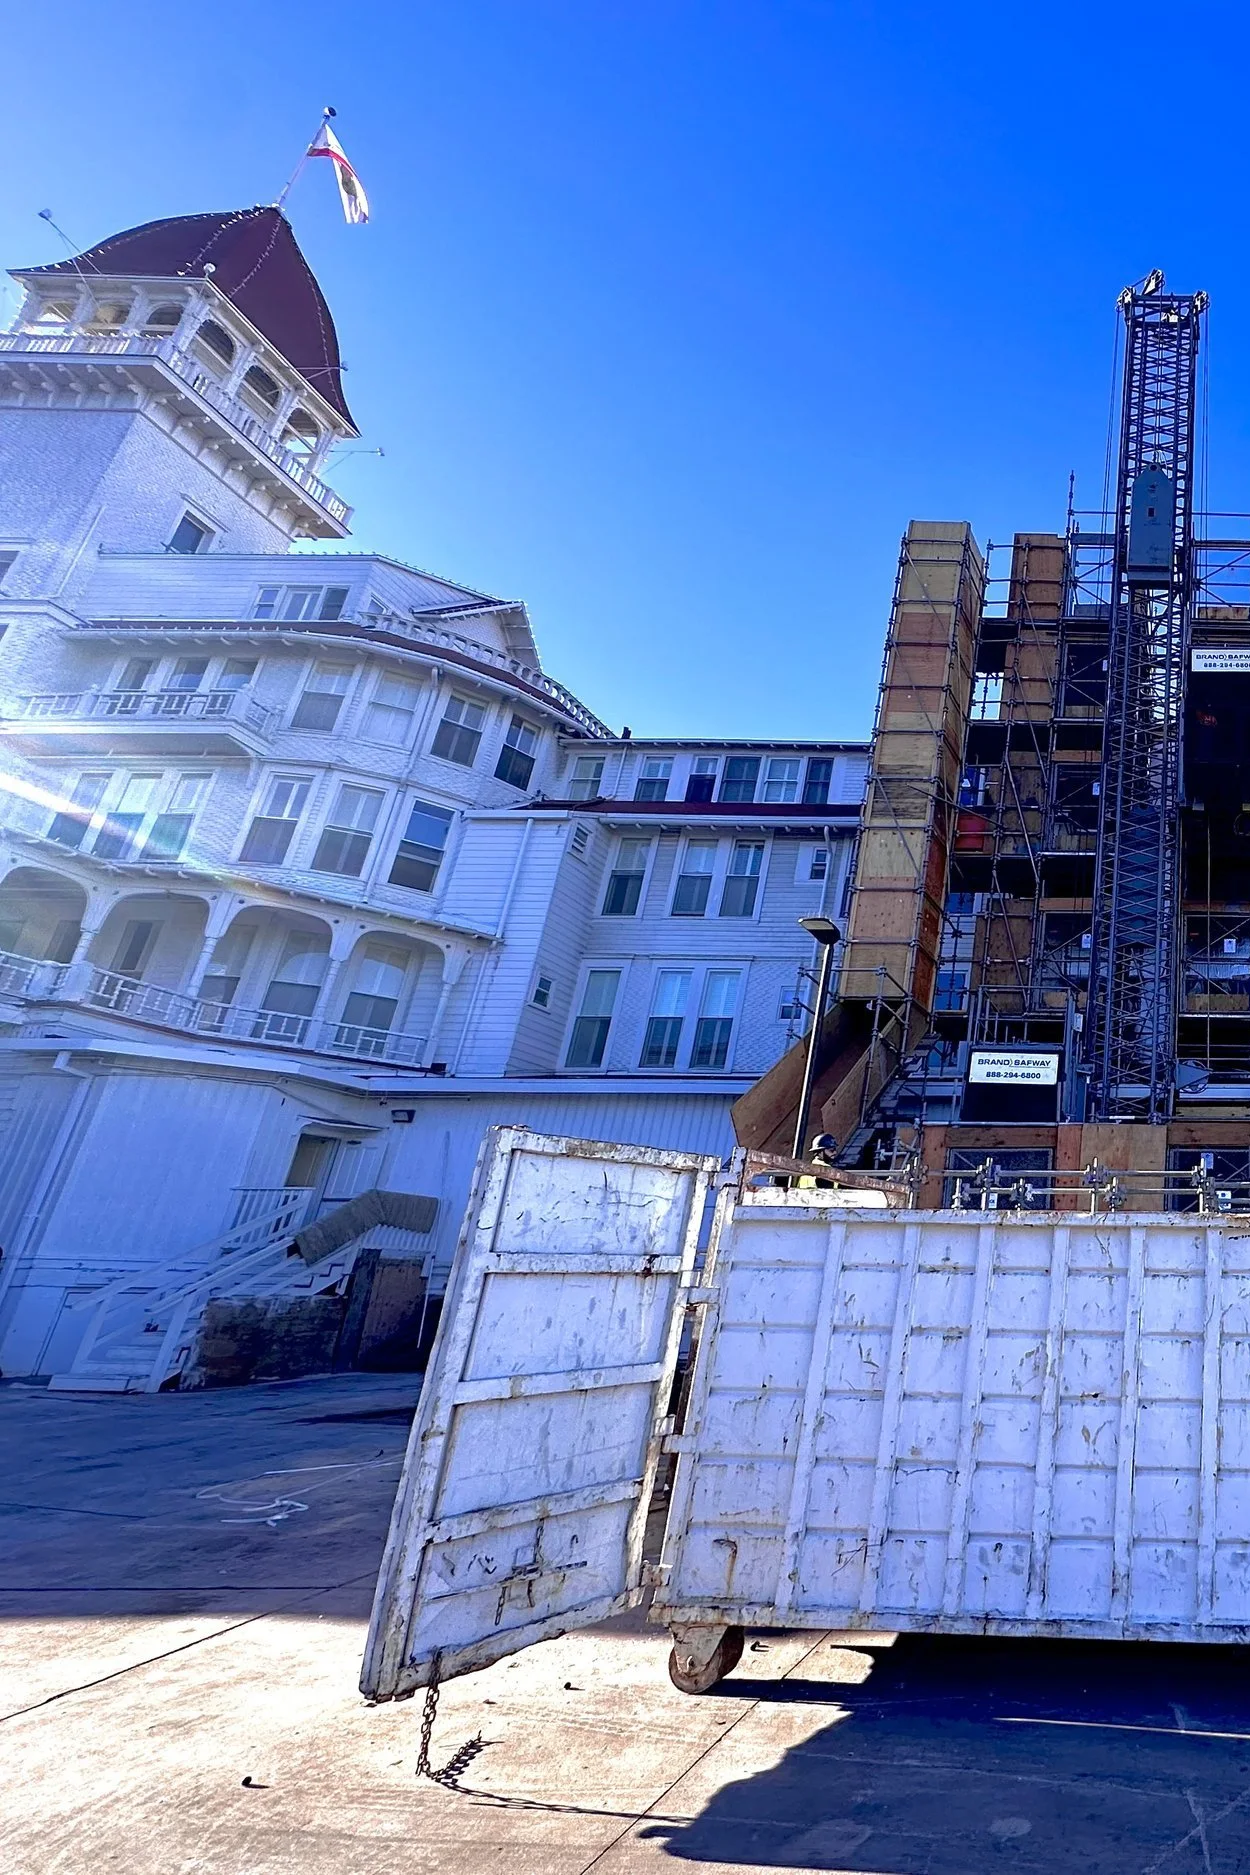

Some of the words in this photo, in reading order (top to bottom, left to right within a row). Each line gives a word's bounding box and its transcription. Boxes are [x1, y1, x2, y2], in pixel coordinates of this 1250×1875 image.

[977, 1058, 1010, 1066] BRAND
[1014, 1059, 1051, 1067] SAFWAY
[986, 1071, 1041, 1079] 888-294-6800
